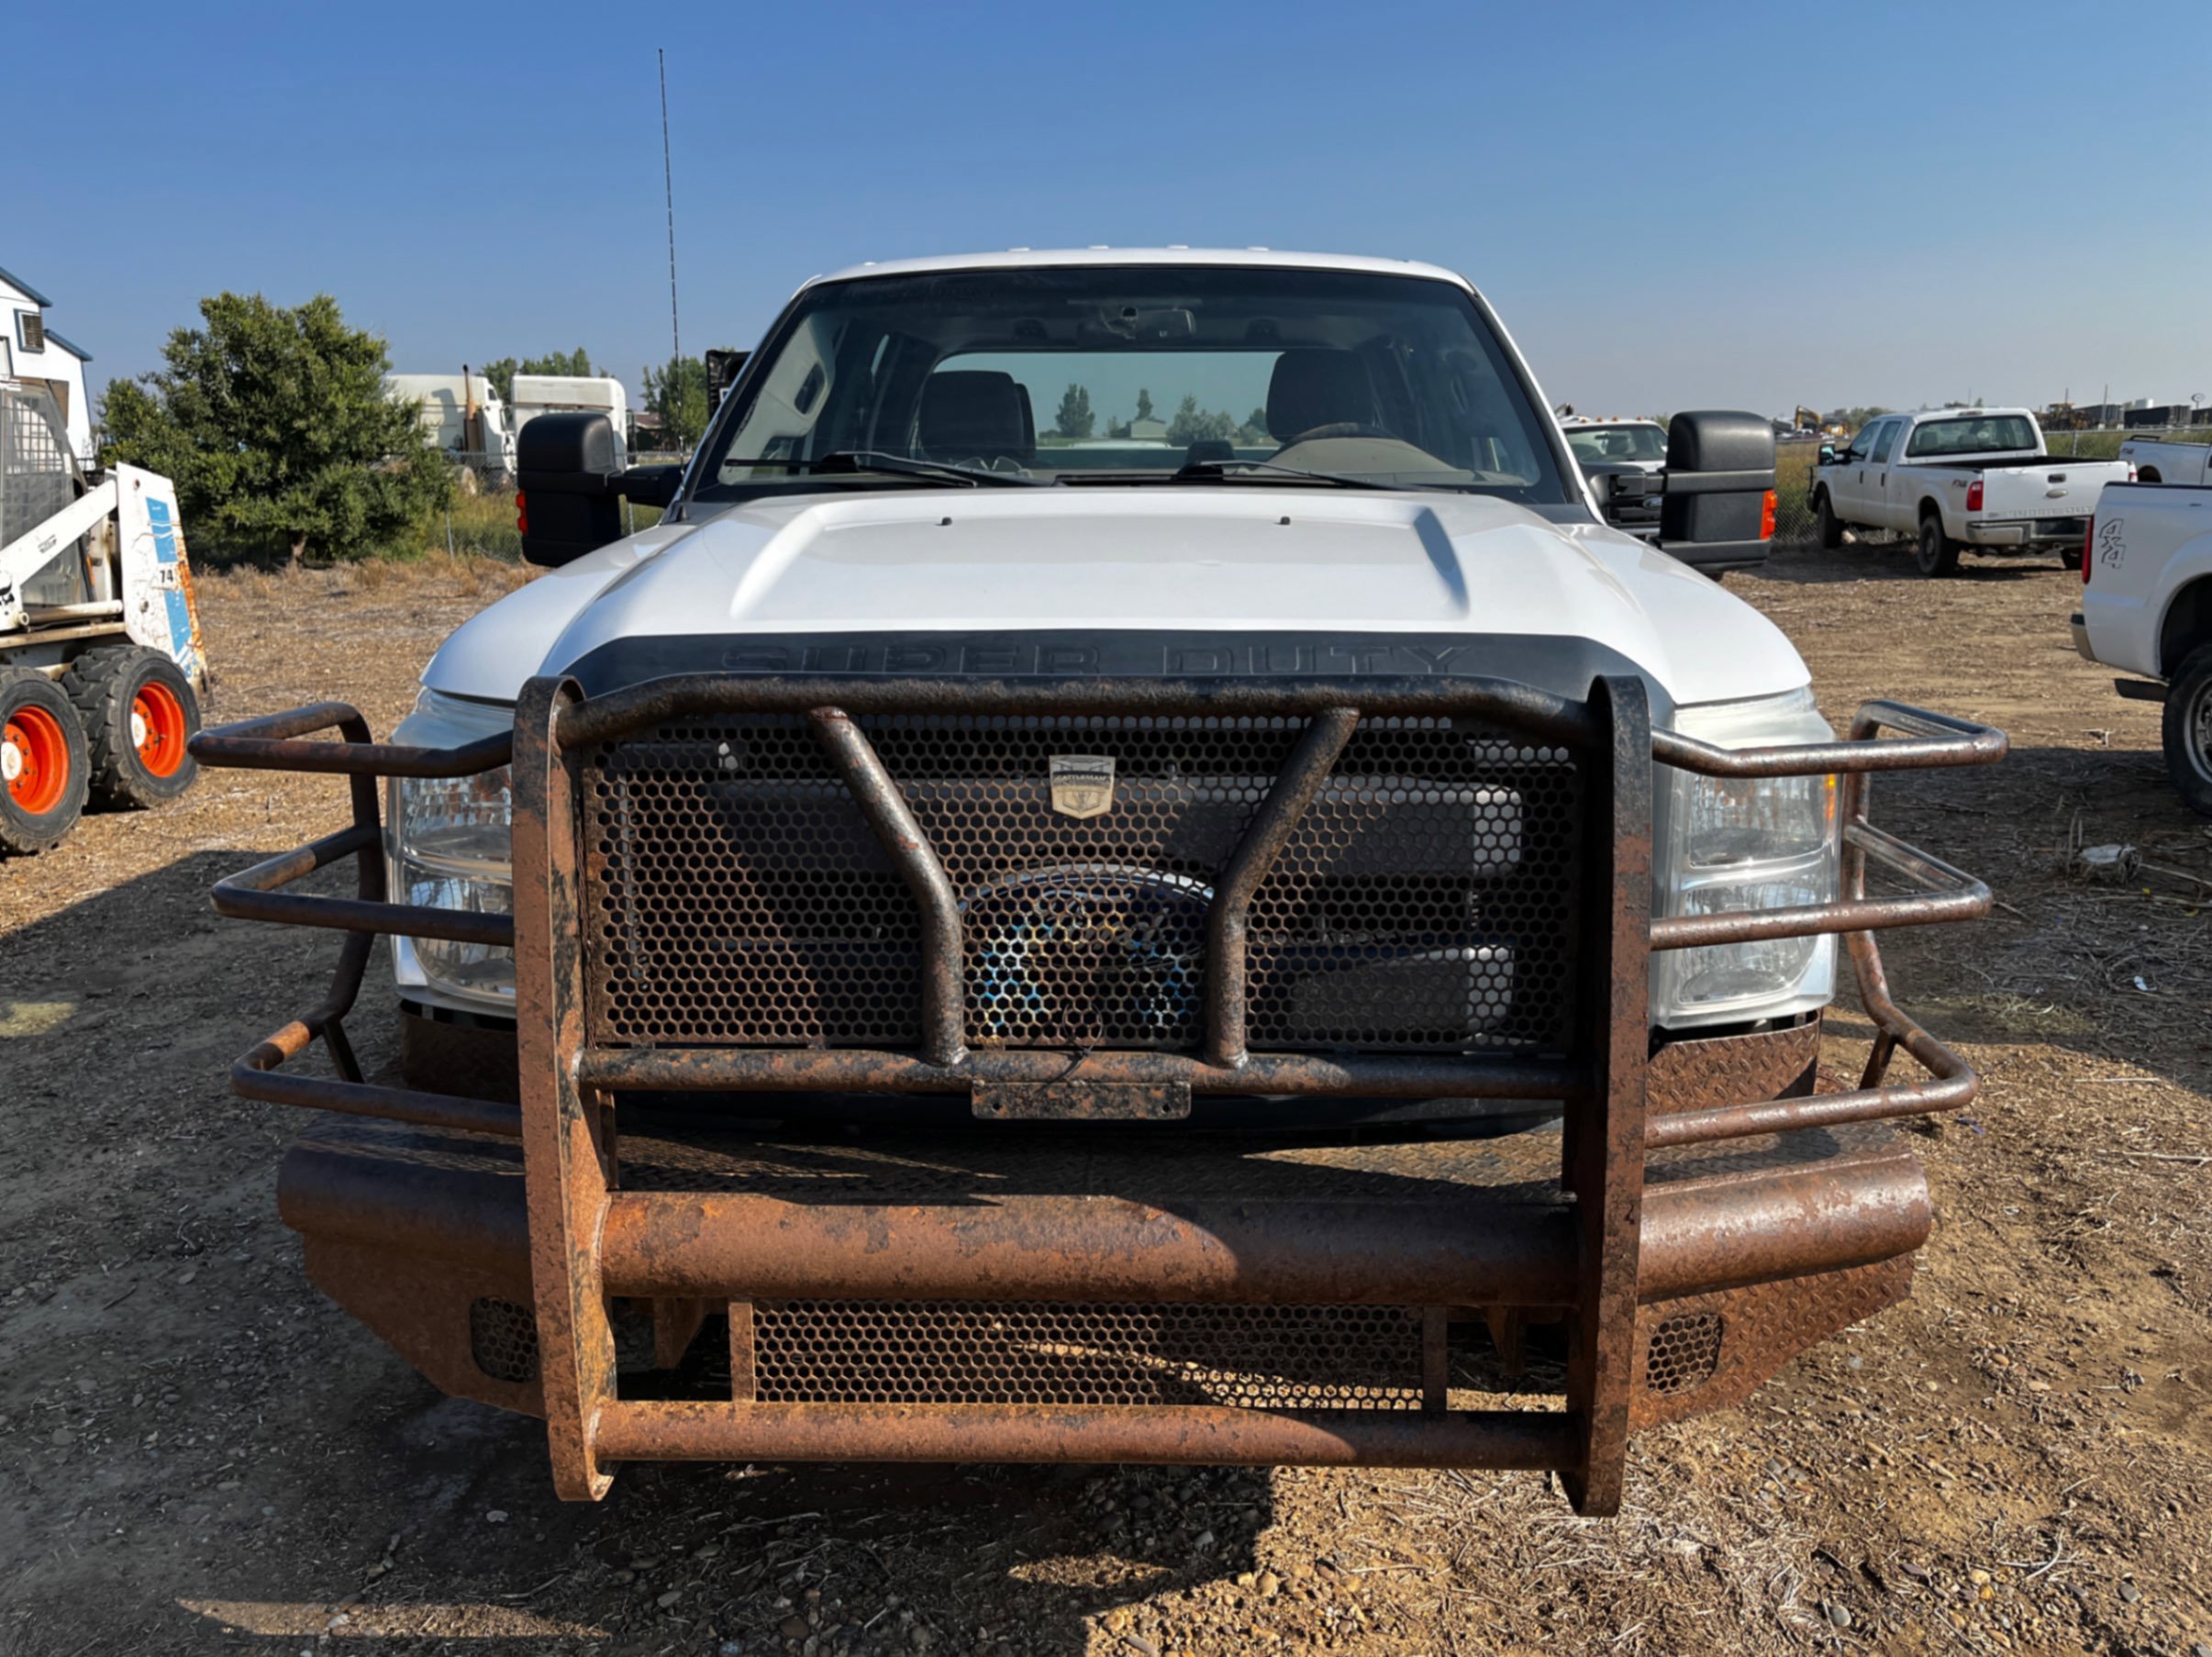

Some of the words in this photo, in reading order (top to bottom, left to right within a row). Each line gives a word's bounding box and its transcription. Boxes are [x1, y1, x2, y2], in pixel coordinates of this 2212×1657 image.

[159, 569, 173, 584] 74
[721, 645, 1101, 674] SUPER
[1164, 645, 1470, 674] DUTY
